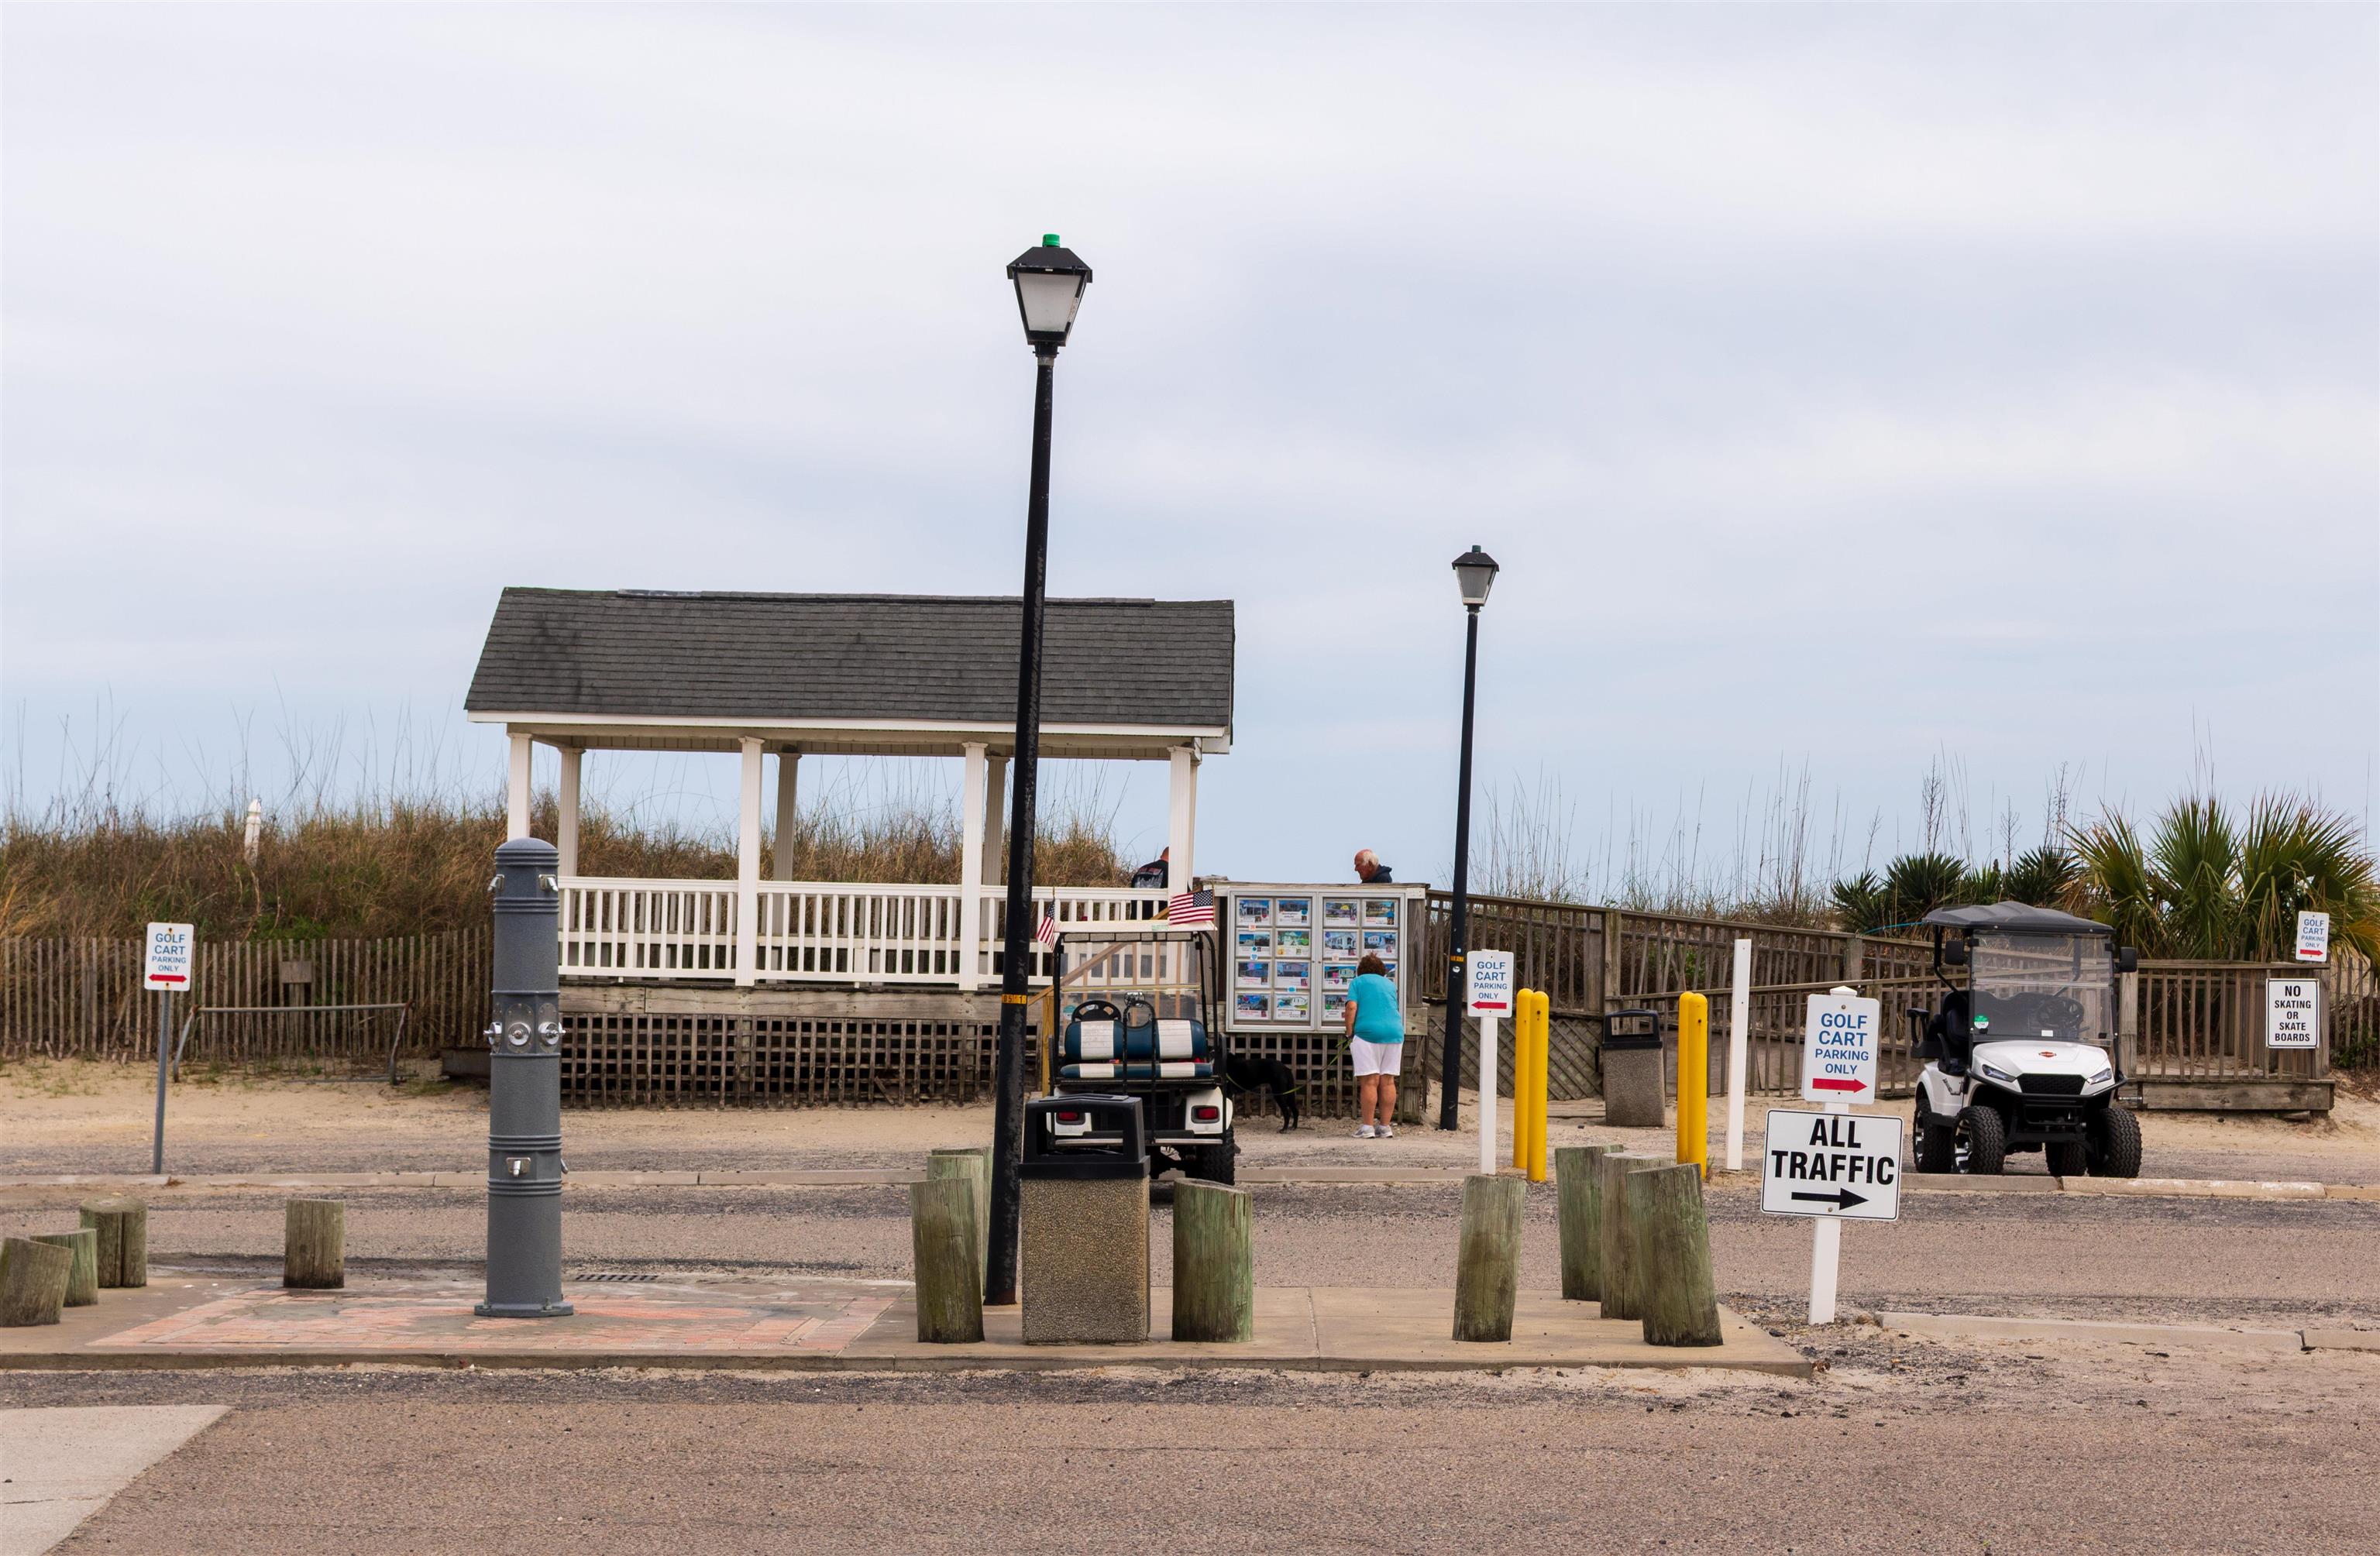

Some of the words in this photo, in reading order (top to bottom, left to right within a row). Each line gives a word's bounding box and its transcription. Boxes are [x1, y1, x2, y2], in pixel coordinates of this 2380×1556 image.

[156, 933, 185, 943] GOLF
[155, 945, 186, 955] CART
[1476, 971, 1506, 981] CART
[2285, 985, 2301, 997] NO
[2274, 1000, 2311, 1008] SKATING
[1821, 1013, 1868, 1029] GOLF
[2286, 1011, 2299, 1020] OR
[2279, 1022, 2306, 1031] SKATE
[1818, 1030, 1868, 1047] CART
[2275, 1033, 2310, 1042] BOARDS
[1815, 1049, 1869, 1061] PARKING
[1825, 1063, 1858, 1075] ONLY
[1809, 1118, 1861, 1149] ALL
[1771, 1150, 1894, 1186] TRAFFIC
